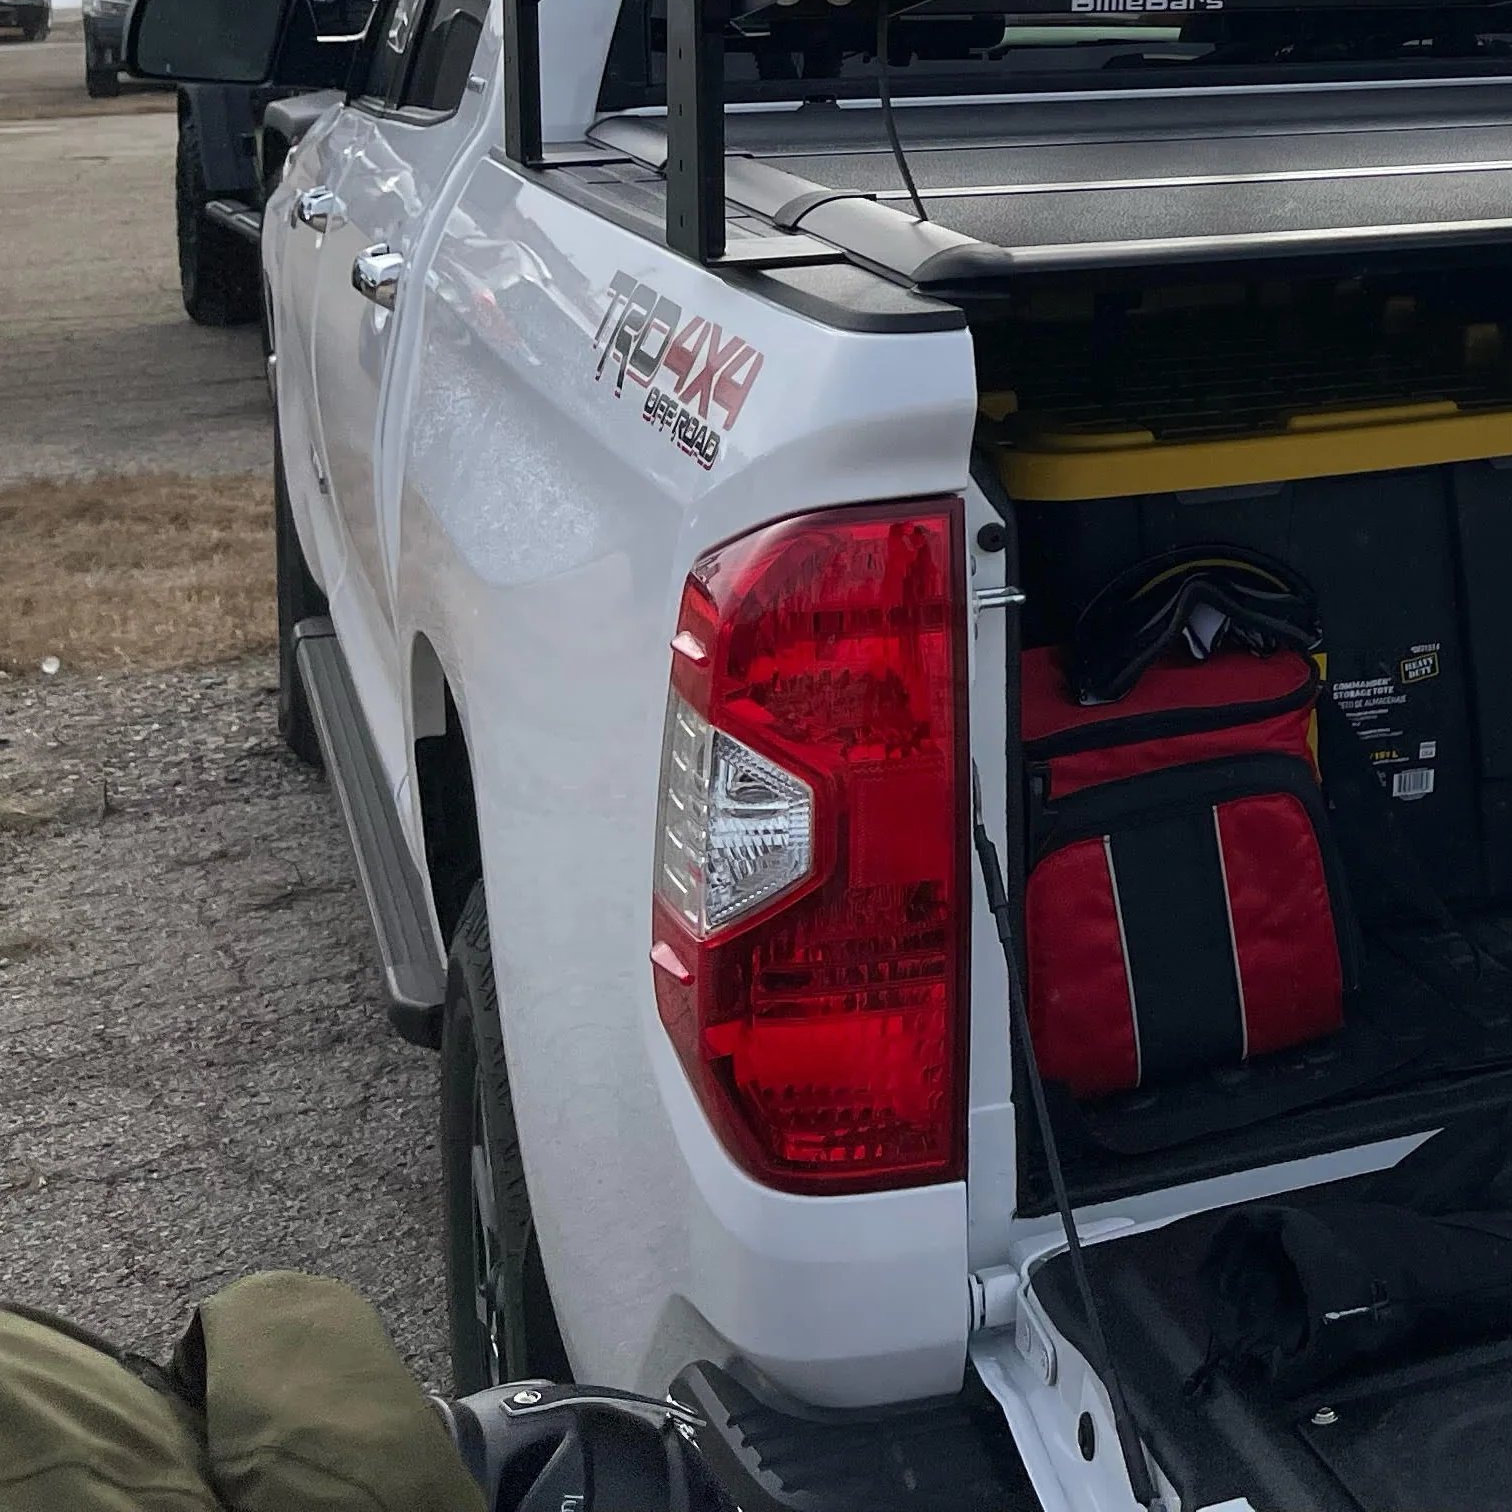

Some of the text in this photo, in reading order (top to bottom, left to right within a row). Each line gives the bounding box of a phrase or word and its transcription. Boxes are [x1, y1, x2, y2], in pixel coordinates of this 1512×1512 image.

[593, 270, 682, 398] TRD
[643, 387, 720, 470] OFF ROAD
